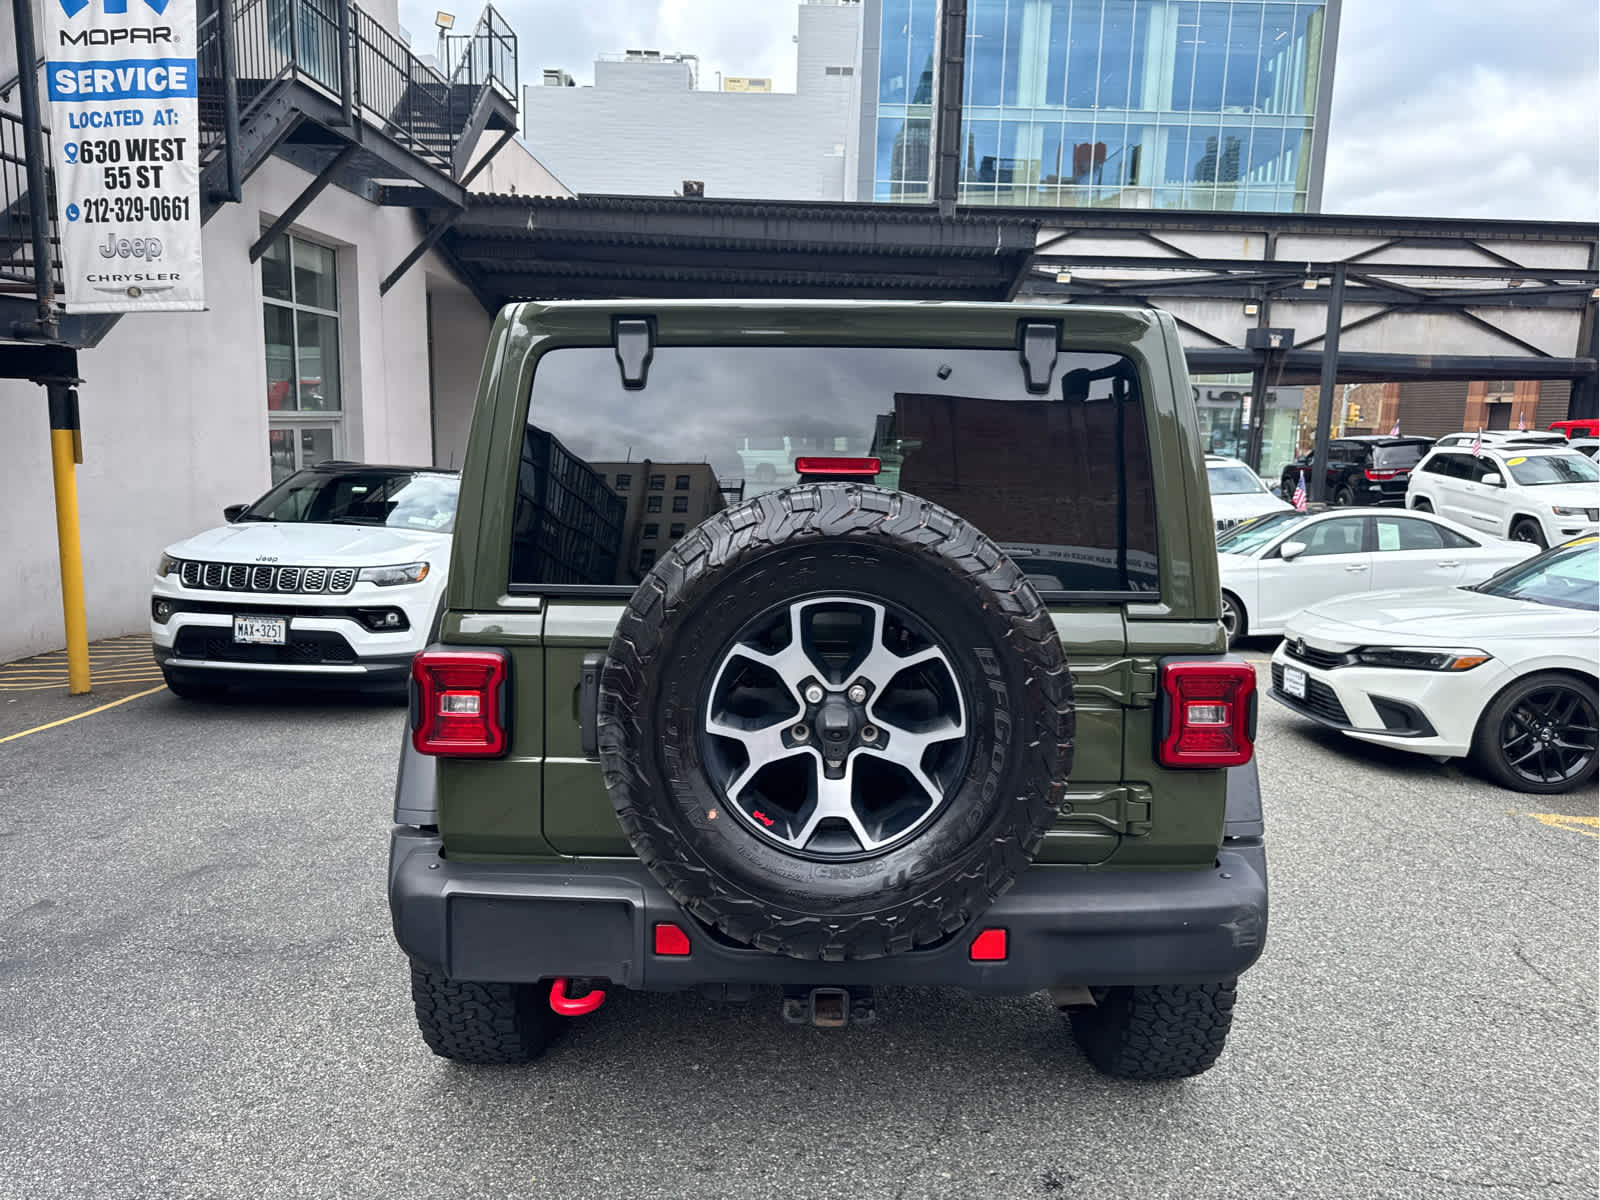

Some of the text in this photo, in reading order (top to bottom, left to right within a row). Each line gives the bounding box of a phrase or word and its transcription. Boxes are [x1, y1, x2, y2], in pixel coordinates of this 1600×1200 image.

[55, 66, 188, 94] SERVICE
[68, 108, 179, 129] LOCATED AT:
[80, 137, 187, 164] 630 WEST
[103, 165, 164, 190] 55 ST
[83, 196, 190, 223] 212-329-0661
[99, 233, 163, 262] Jeep
[86, 273, 181, 282] CHRYSLER
[255, 554, 279, 563] Jeep
